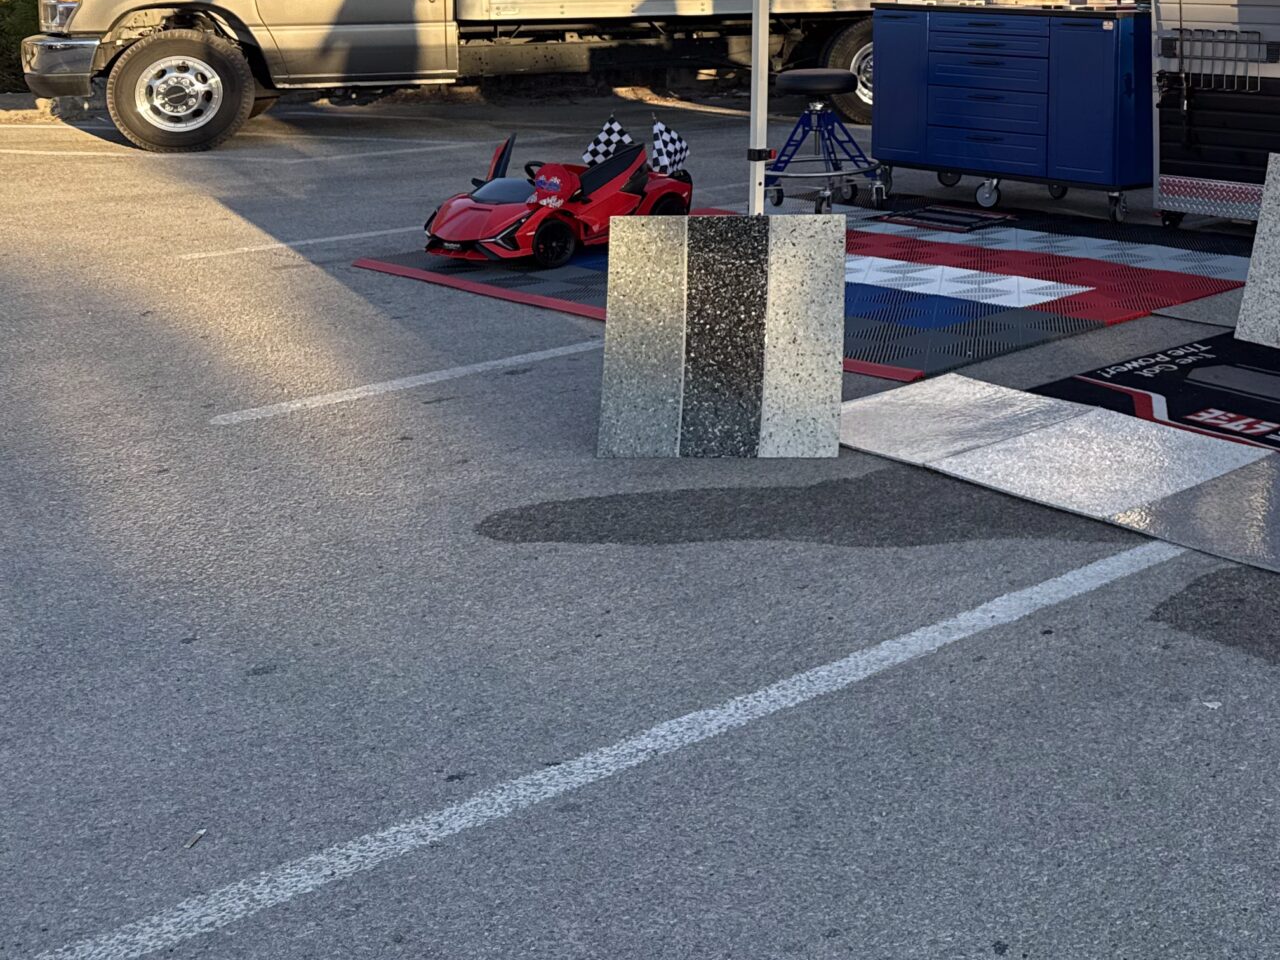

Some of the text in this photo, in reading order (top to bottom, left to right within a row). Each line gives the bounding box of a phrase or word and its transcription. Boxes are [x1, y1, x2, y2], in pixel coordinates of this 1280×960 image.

[1096, 342, 1212, 378] The Power!
[1134, 363, 1179, 378] Got
